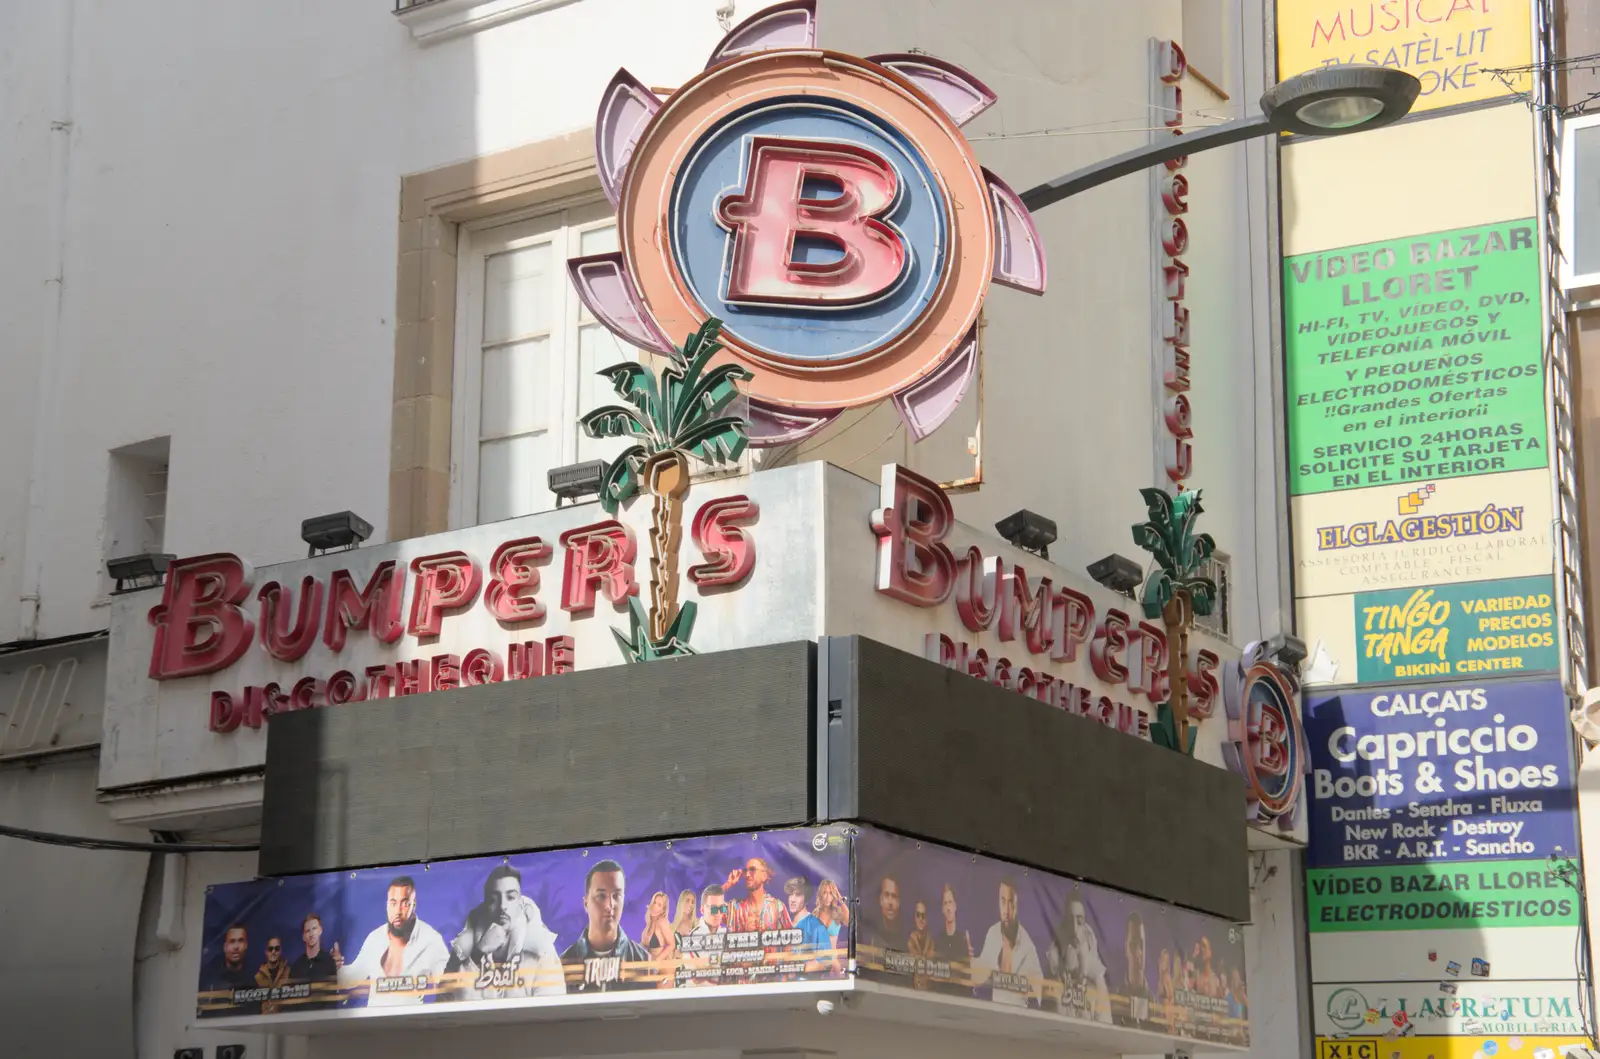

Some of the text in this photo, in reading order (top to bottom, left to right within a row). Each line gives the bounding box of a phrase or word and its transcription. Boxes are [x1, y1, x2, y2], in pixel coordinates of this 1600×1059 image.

[1366, 27, 1492, 67] SATÈL-LIT
[715, 134, 914, 310] B
[1160, 38, 1194, 492] DICOTHEQU
[1290, 227, 1533, 284] VÍDEO BAZAR
[1342, 265, 1479, 306] LLORET
[1298, 292, 1530, 334] HI-FI, TV, VÍDEO, DVD,
[1327, 312, 1501, 346] VIDEOJUEGOS Y
[1318, 328, 1512, 365] TELEFONÍA MÓVIL
[1345, 353, 1483, 381] Y PEQUEÑOS
[1297, 364, 1538, 406] ELECTRODOMÉSTICOS
[1428, 386, 1508, 404] Ofertas
[1313, 423, 1524, 459] SERVICIO 24HORAS
[1343, 421, 1367, 433] en
[1374, 415, 1392, 429] el
[1299, 437, 1540, 476] SOLICITE SU TARJETA
[1332, 457, 1506, 488] EN EL INTERIOR
[1317, 504, 1524, 551] ELCLAGESTIÓN
[1339, 559, 1430, 575] COMPTABLE
[1450, 552, 1506, 565] FISCAL
[1362, 566, 1482, 584] ASSEGURANCES
[148, 494, 757, 680] BUMPERS
[870, 463, 1220, 719] BUMPERS
[1460, 594, 1551, 614] VARIEDAD
[1363, 588, 1450, 630] TINGO
[1479, 613, 1552, 632] PRECIOS
[1363, 626, 1449, 664] TANGA
[1467, 632, 1553, 652] MODELOS
[1395, 656, 1523, 677] BIKINI CENTER
[208, 635, 575, 734] DISCOTHEQUE
[1370, 688, 1488, 718] CALÇATS
[1247, 703, 1288, 776] B
[1328, 714, 1539, 770] Capriccio
[1314, 756, 1559, 799] Boots & Shoes
[1332, 805, 1391, 822] Dantes
[1408, 800, 1473, 818] Sendra
[1491, 796, 1543, 814] Fluxa
[1345, 826, 1388, 841] New
[1392, 820, 1436, 838] Rock
[1452, 819, 1524, 839] Destroy
[1343, 845, 1379, 862] BKR
[1396, 842, 1448, 860] A.R.T.
[1465, 837, 1535, 857] Sancho
[1312, 872, 1382, 897] VÍDEO
[1390, 873, 1471, 893] BAZAR
[1320, 899, 1572, 923] ELECTRODOMESTICOS
[762, 929, 803, 946] CLUB
[1461, 1022, 1578, 1033] IMOBILIRIA
